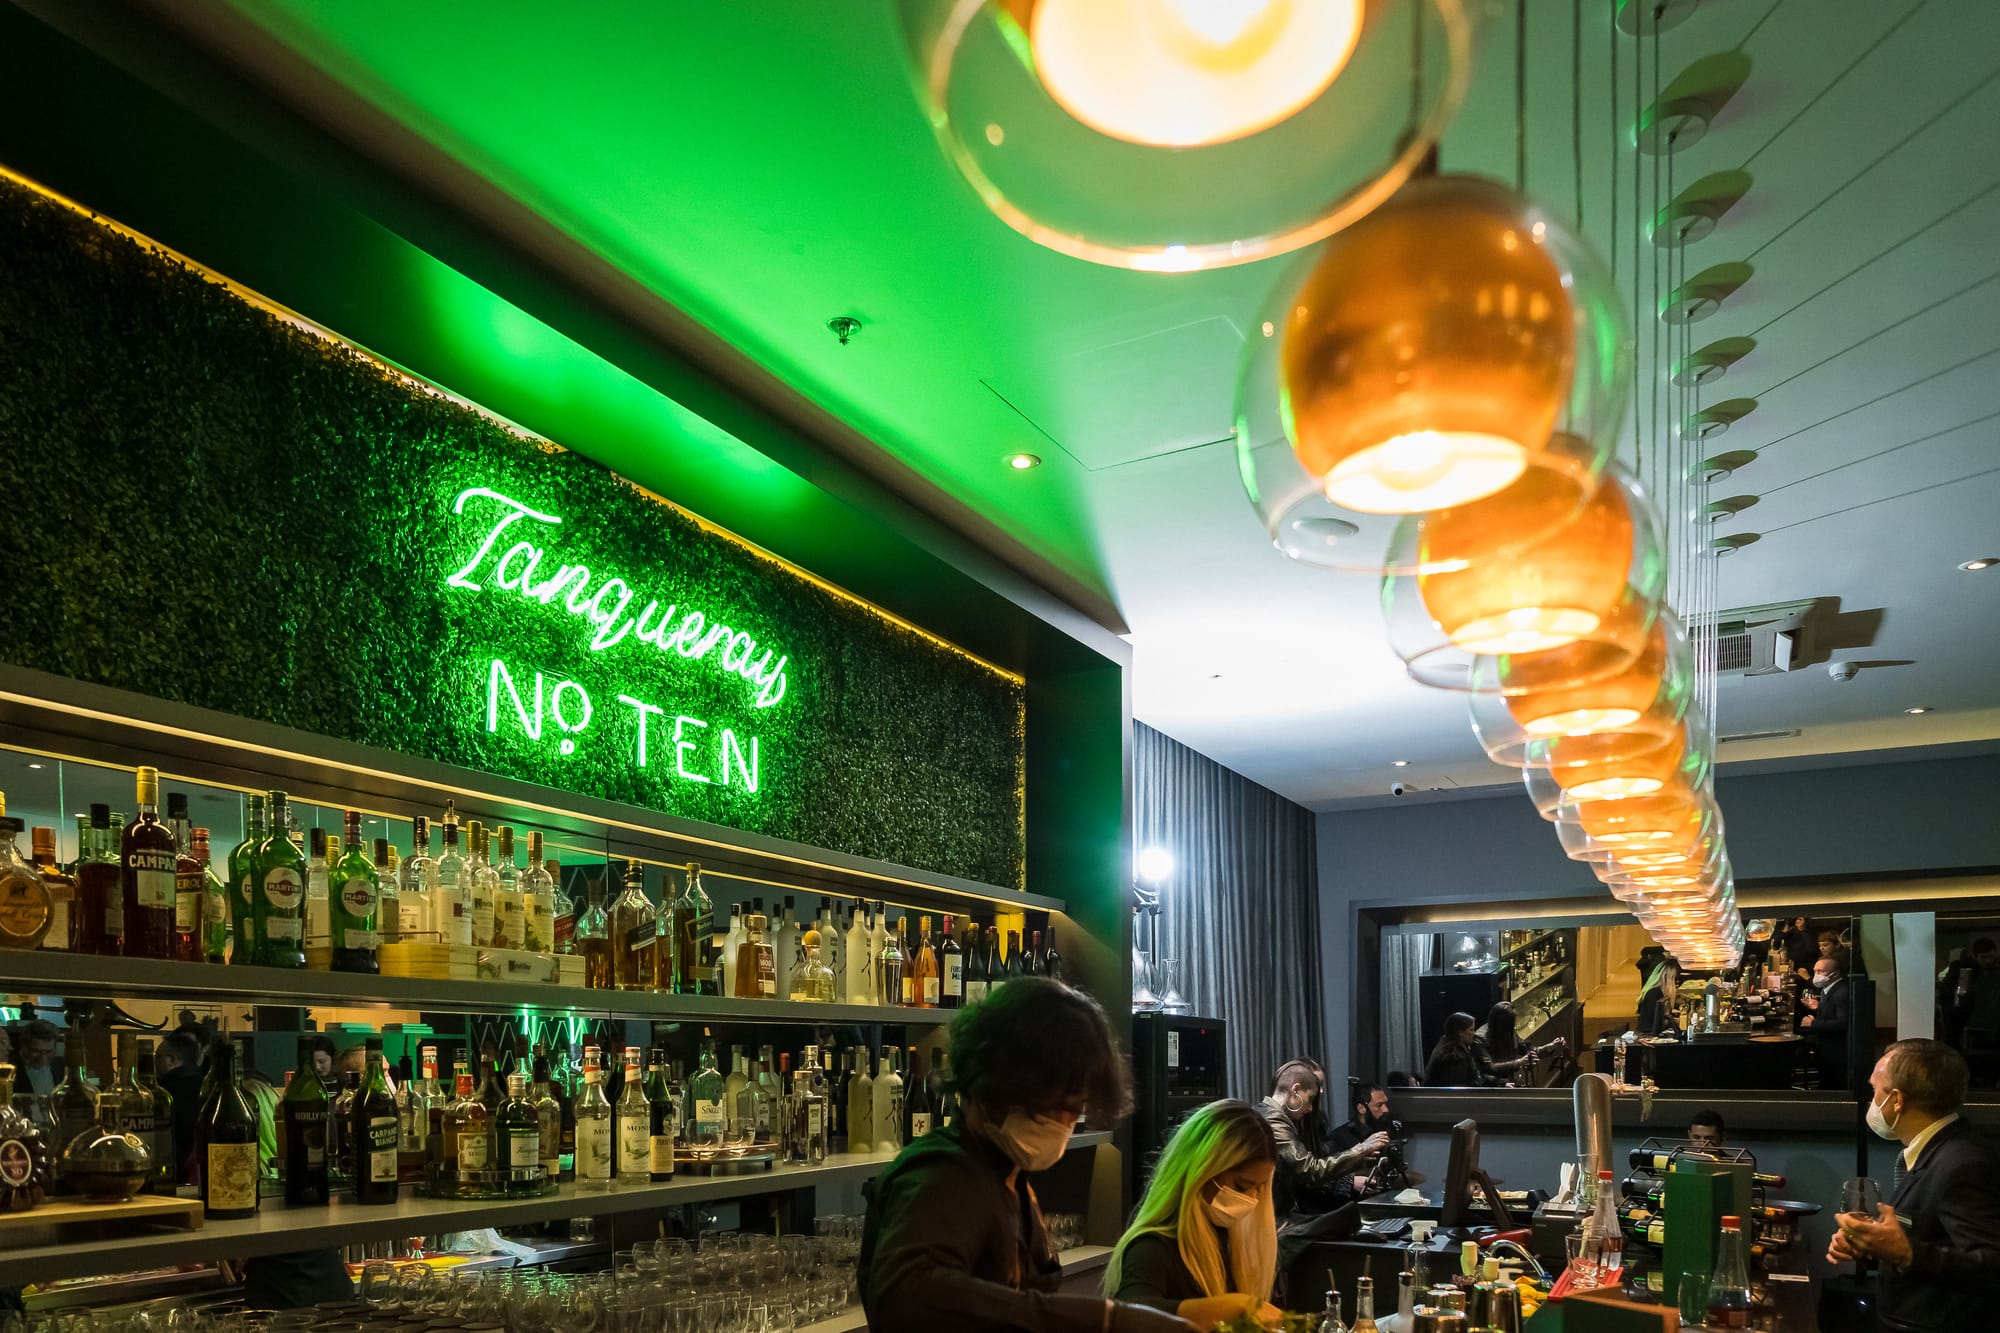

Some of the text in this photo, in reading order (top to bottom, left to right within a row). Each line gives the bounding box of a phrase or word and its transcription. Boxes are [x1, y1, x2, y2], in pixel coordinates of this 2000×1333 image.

[447, 487, 787, 708] Tanqueray
[618, 694, 759, 792] TEN
[129, 854, 176, 871] CAMPAR
[176, 879, 201, 889] EROL
[267, 883, 301, 893] MARTI
